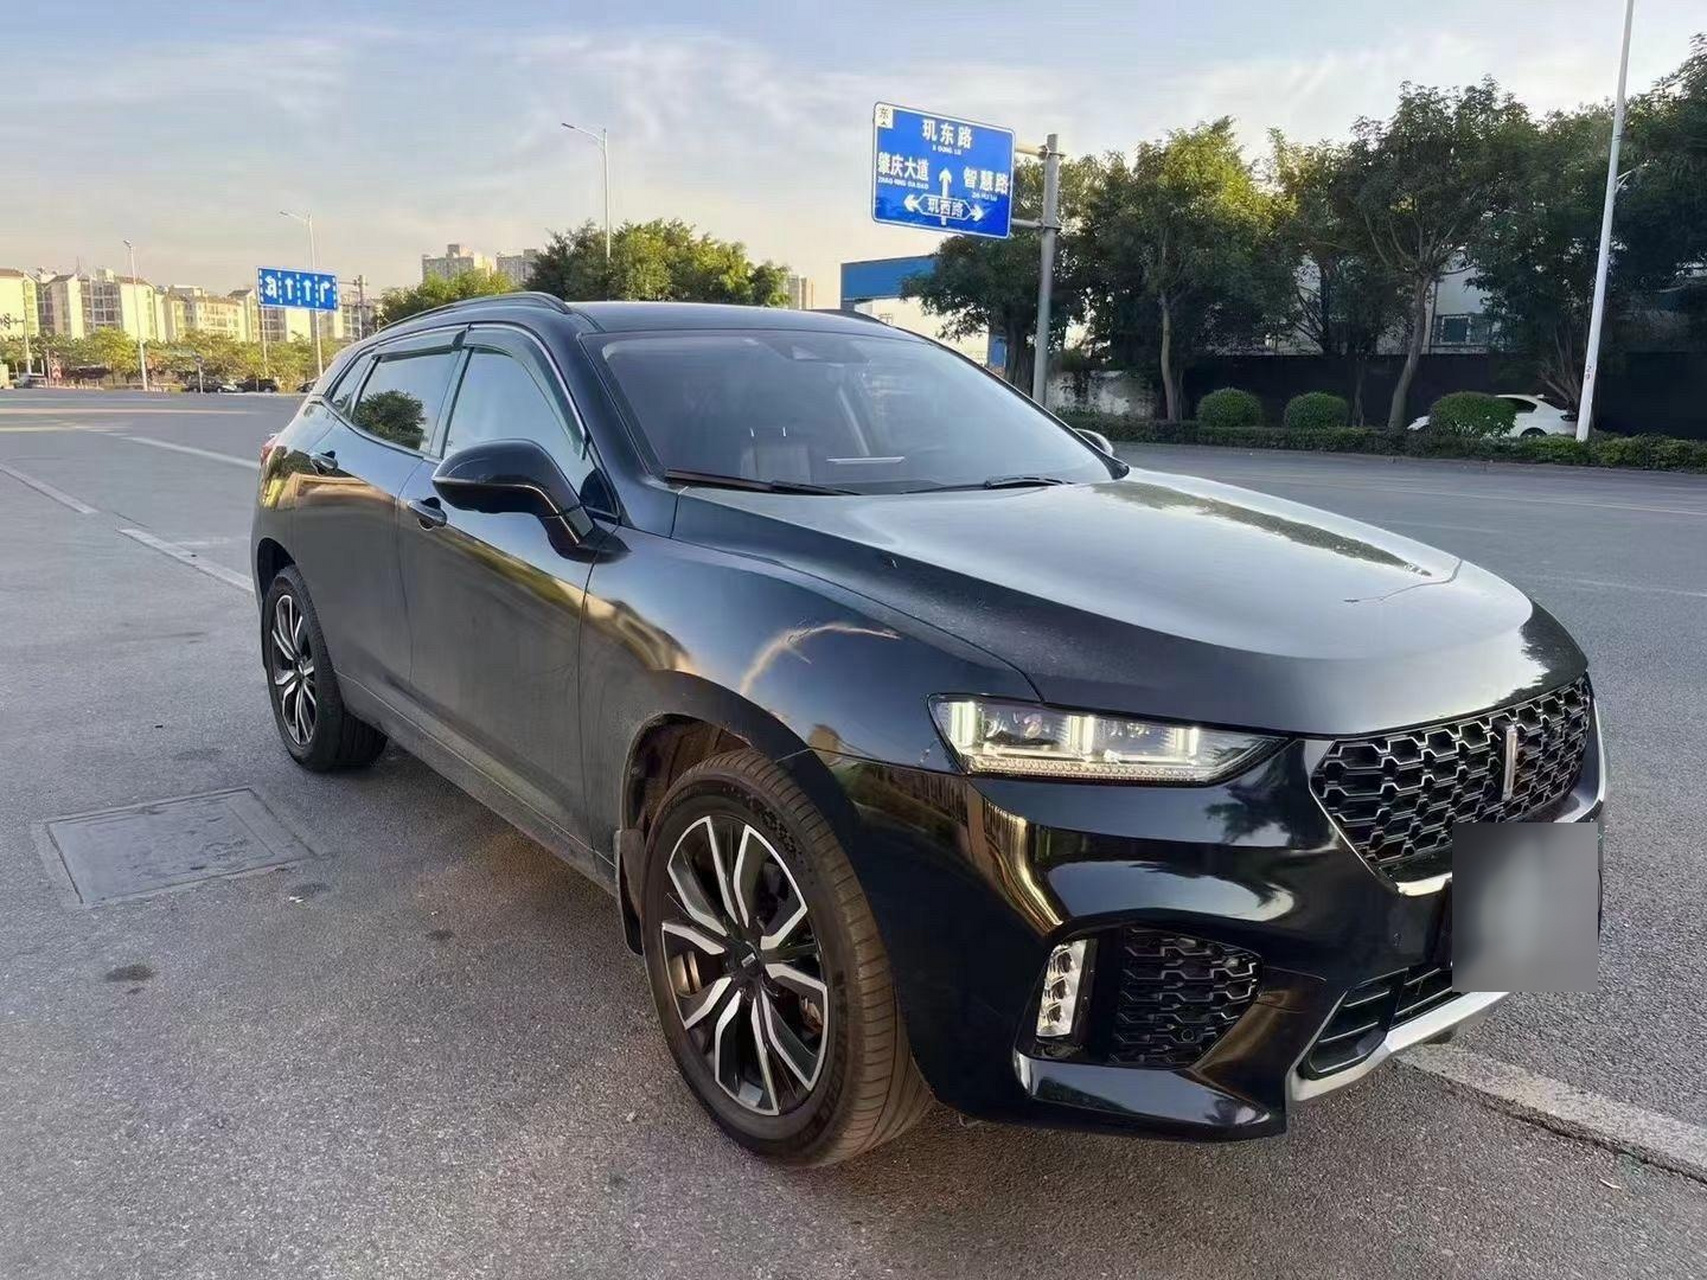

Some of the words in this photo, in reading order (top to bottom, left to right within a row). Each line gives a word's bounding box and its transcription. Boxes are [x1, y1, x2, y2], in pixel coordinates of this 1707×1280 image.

[878, 151, 929, 182] 肇庆大道
[963, 167, 1009, 195] 智慧路
